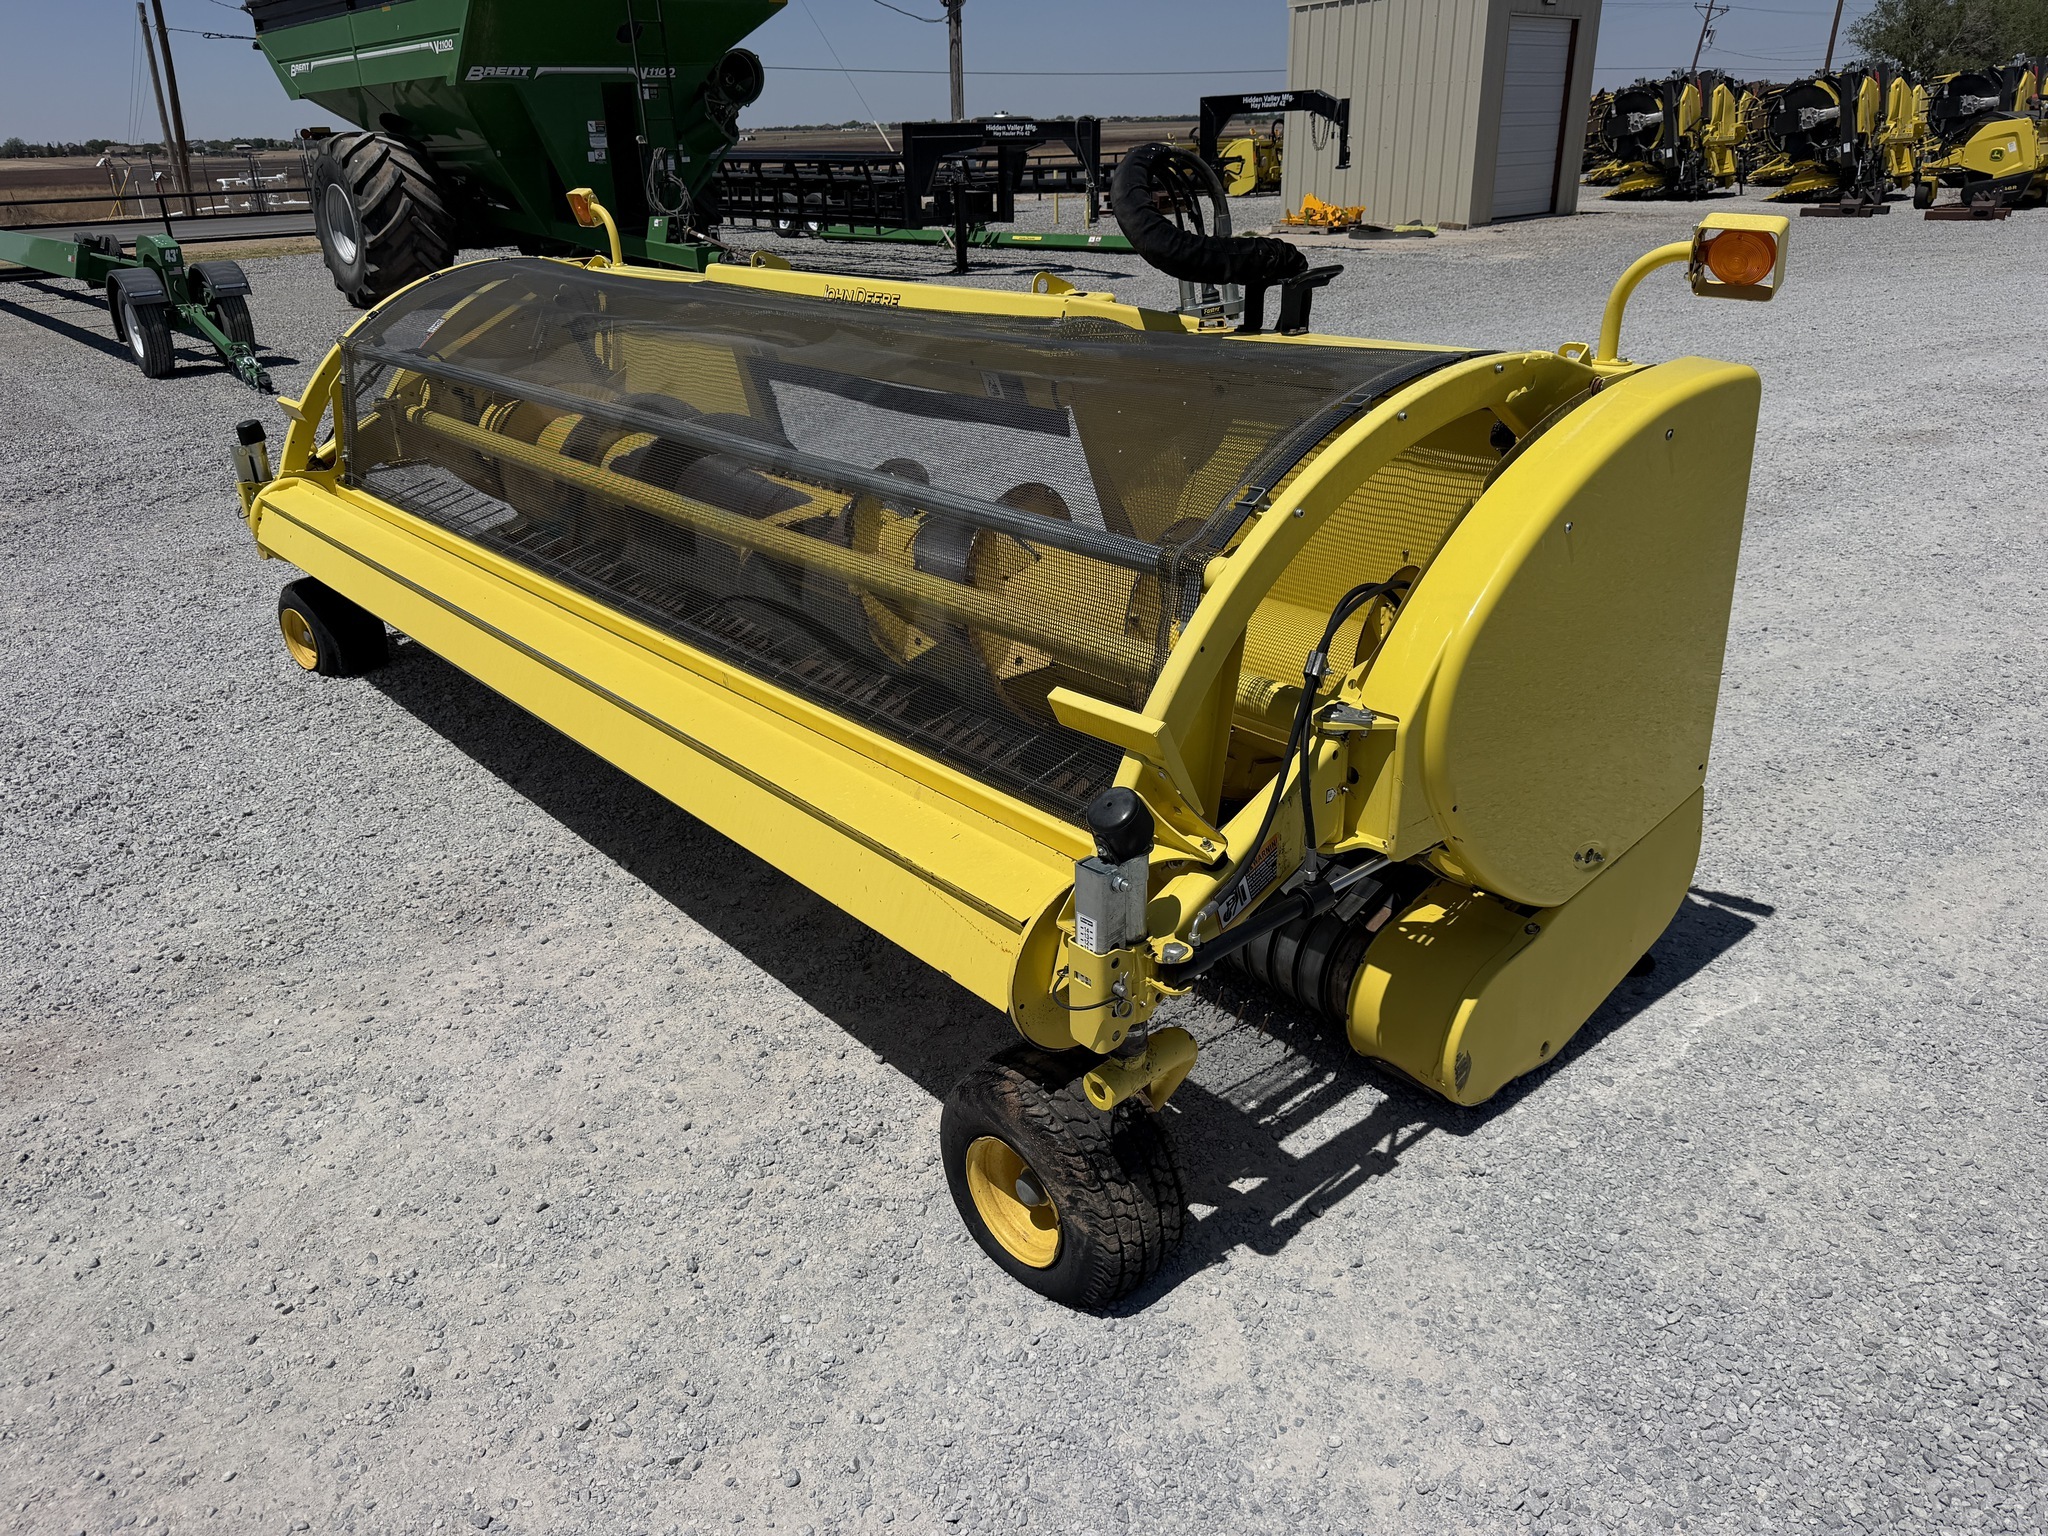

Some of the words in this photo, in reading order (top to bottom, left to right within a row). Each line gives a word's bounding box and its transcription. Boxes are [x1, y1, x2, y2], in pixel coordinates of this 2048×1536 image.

[290, 62, 310, 77] BRENT
[465, 66, 531, 80] BRENT
[1242, 95, 1262, 104] Hidden
[1263, 94, 1281, 103] Valley
[1281, 93, 1294, 102] Mfg.
[1250, 102, 1260, 110] Hay
[1006, 124, 1024, 132] Valley
[1024, 124, 1037, 132] Mfg.
[823, 284, 854, 302] JOHN
[855, 287, 901, 308] DEERE
[1250, 838, 1278, 869] WARNIN
